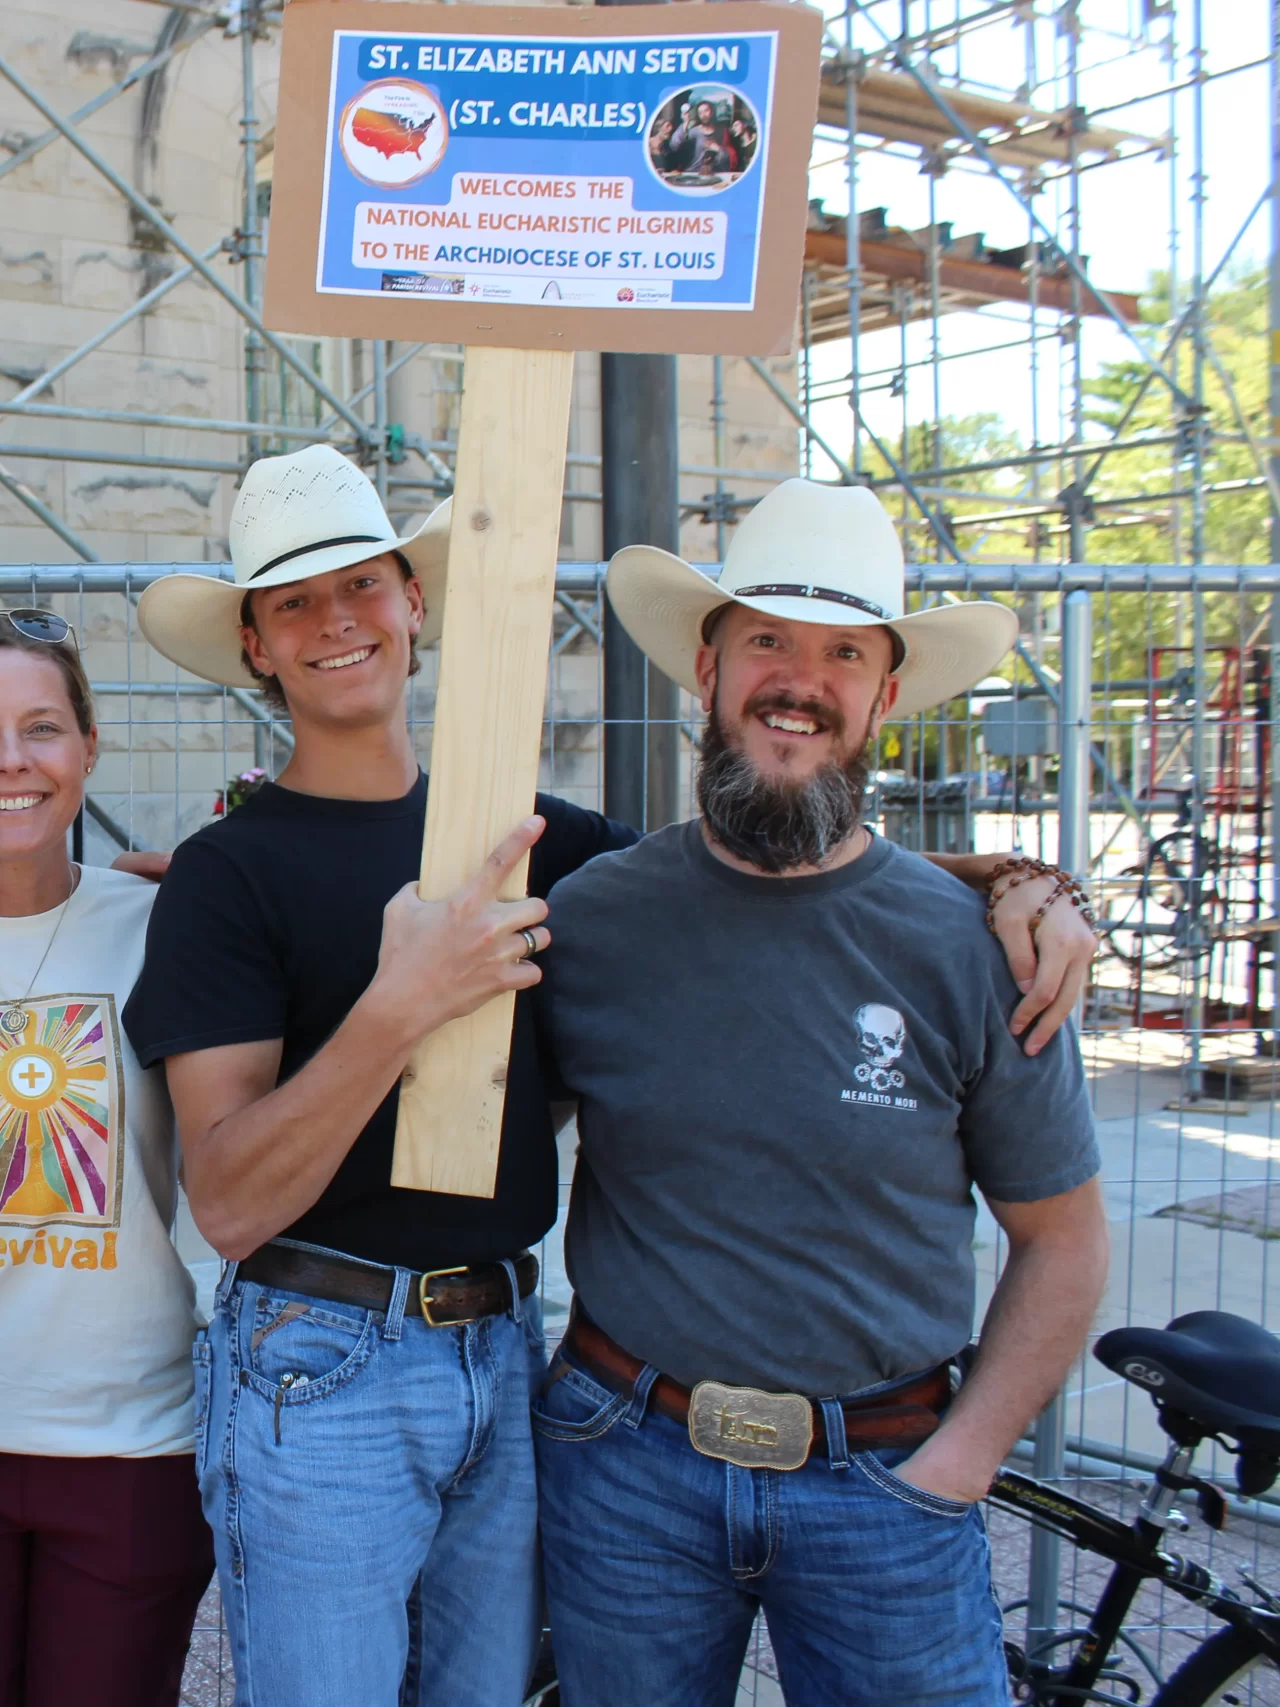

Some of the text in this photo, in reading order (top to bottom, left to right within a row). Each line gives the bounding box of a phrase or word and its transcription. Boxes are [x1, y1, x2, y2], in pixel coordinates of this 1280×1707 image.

[368, 44, 739, 75] ST. ELIZABETH ANN SETON
[449, 99, 646, 134] (ST. CHARLES)
[460, 178, 624, 199] WELCOMES THE
[367, 208, 714, 235] NATIONAL EUCHARISTIC PILGRIMS
[360, 241, 716, 269] TO THE ARCHDIOCESE OF ST. LOUIS
[841, 1089, 917, 1109] MEMENTO MORI
